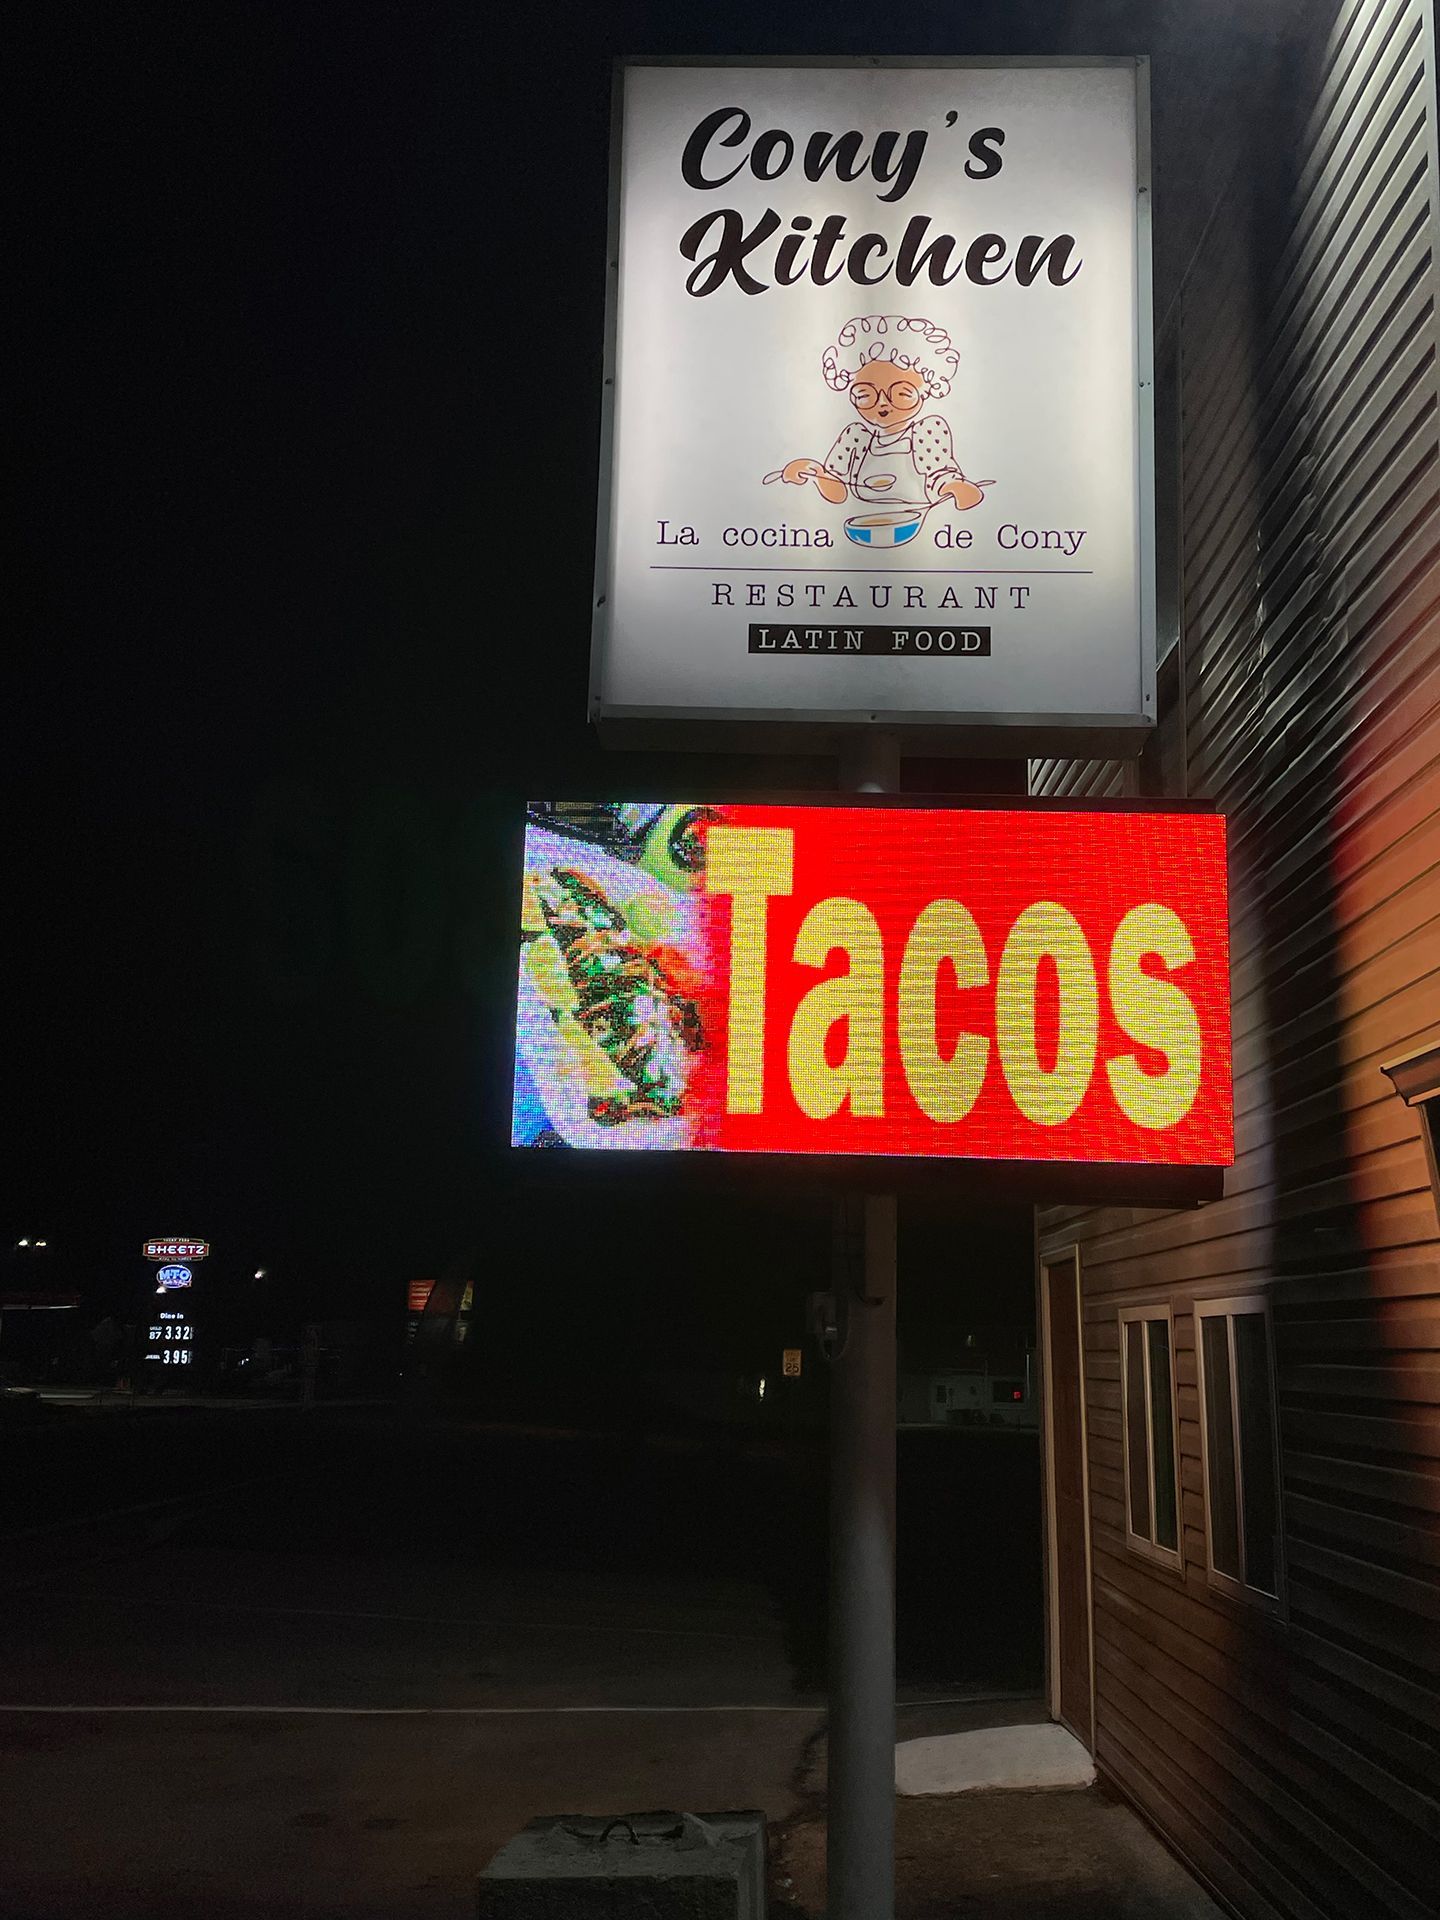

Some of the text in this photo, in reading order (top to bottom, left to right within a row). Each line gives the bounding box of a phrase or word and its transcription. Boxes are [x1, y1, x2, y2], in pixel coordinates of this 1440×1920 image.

[681, 106, 1006, 203] Cony's
[679, 207, 1083, 298] Kitchen
[656, 520, 1087, 555] La cocina de Cony
[711, 583, 1031, 610] RESTAURANT
[757, 629, 982, 653] LATIN FOOD
[705, 826, 1203, 1130] Tacos
[147, 1245, 205, 1255] SHEETZ
[149, 1331, 161, 1340] 87
[165, 1325, 189, 1340] 3.32
[163, 1349, 188, 1364] 3.95
[785, 1362, 799, 1373] 25
